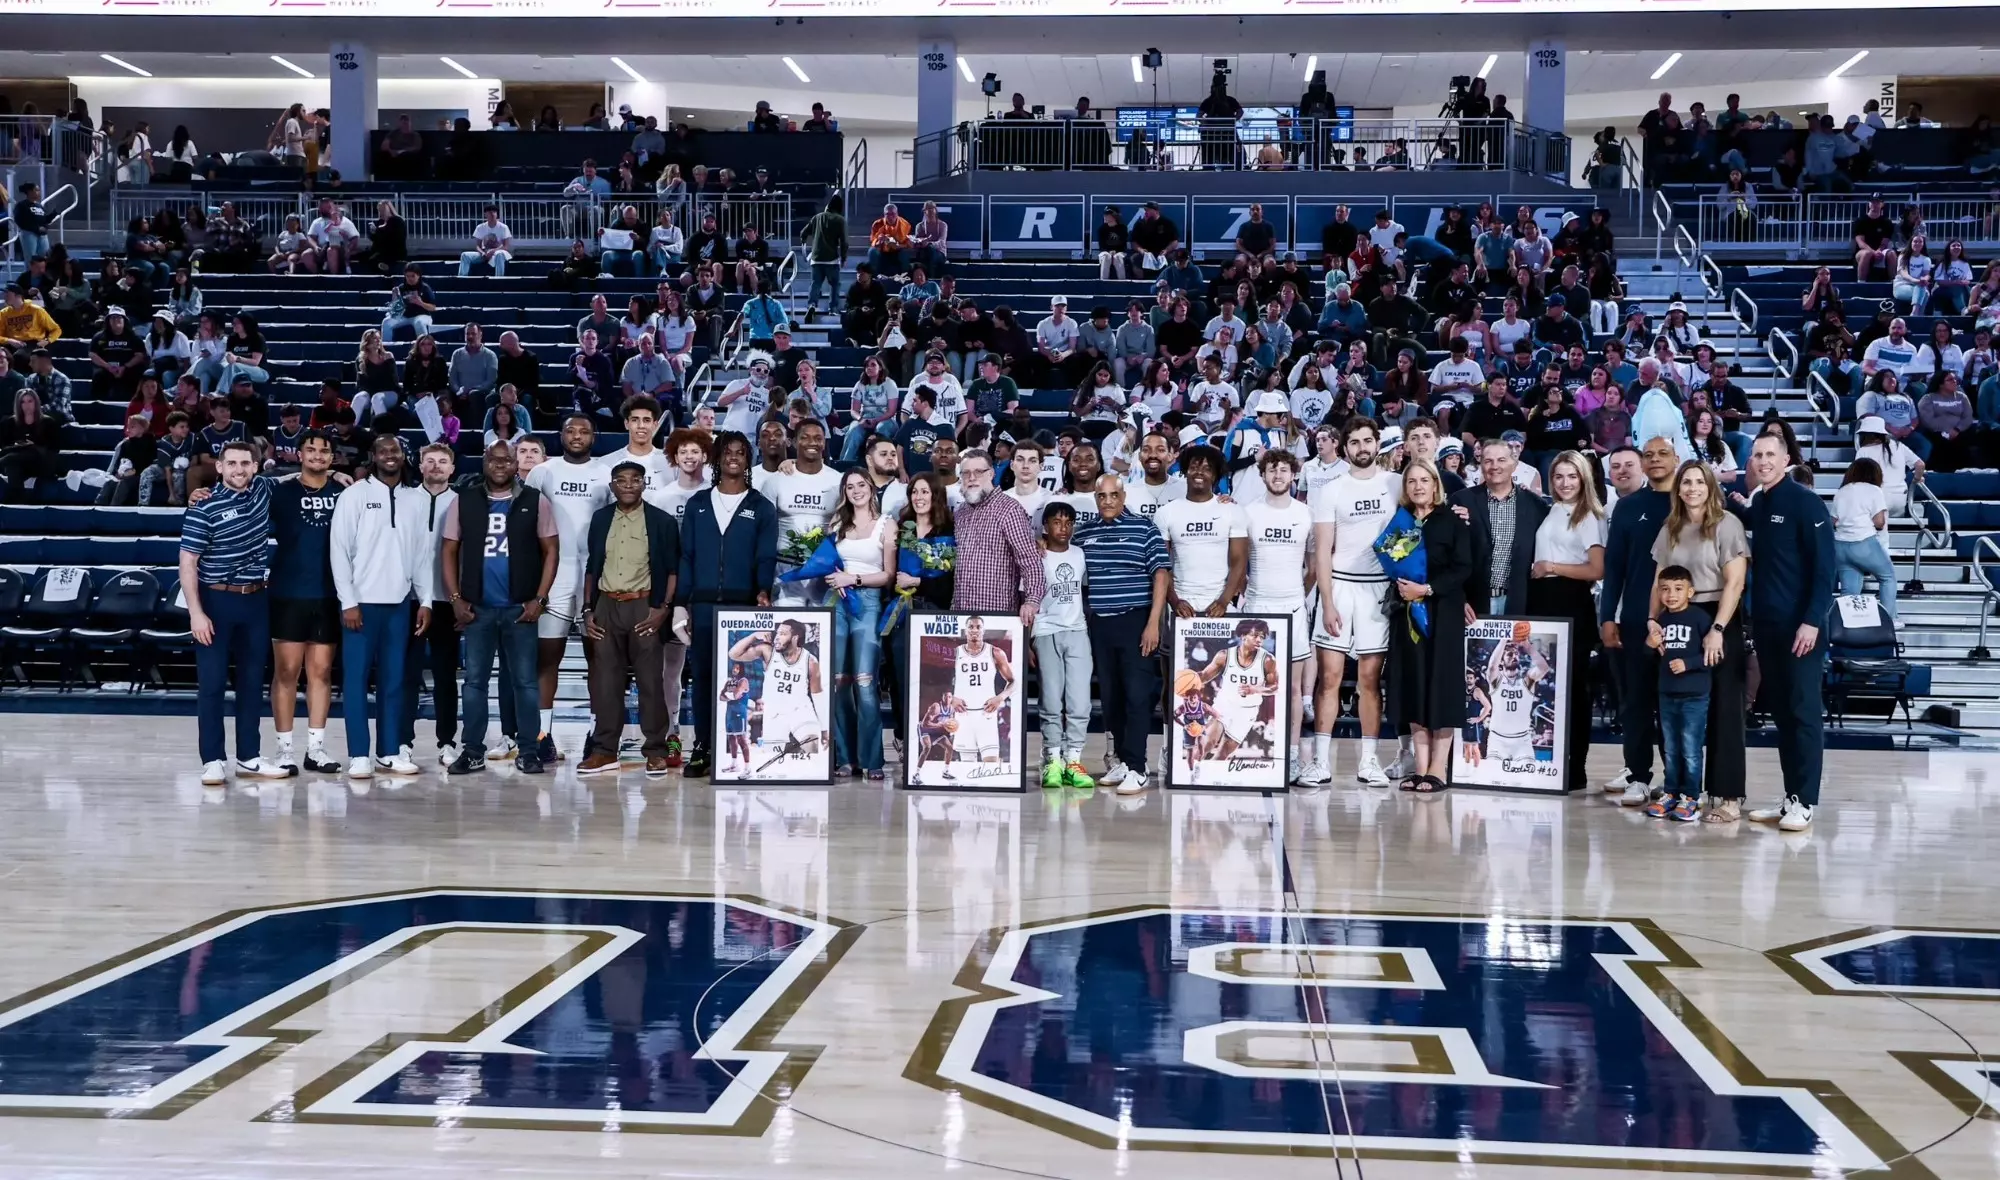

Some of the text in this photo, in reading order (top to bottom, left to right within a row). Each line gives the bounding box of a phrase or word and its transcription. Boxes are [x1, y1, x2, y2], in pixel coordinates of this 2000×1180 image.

[339, 53, 354, 61] 107
[928, 53, 944, 61] 108
[1540, 50, 1557, 58] 109
[927, 62, 943, 70] 109
[1538, 59, 1556, 68] 110
[1881, 82, 1895, 118] MEN
[1118, 118, 1147, 127] OPEN
[1018, 206, 1058, 239] R
[748, 404, 761, 413] UP
[560, 481, 588, 493] CBU
[301, 496, 335, 510] CBU
[793, 494, 821, 505] CBU
[1355, 499, 1381, 511] CBU
[788, 503, 826, 511] BASKETBALL
[221, 508, 239, 520] CBU
[1349, 509, 1387, 517] BASKETBALL
[1770, 514, 1784, 523] CBU
[1186, 522, 1213, 532] CBU
[1264, 528, 1292, 539] CBU
[484, 536, 509, 557] 24
[720, 620, 774, 629] OUEDRAOGO
[924, 622, 959, 635] WADE
[1192, 622, 1231, 630] BLONDEAU
[1484, 621, 1512, 629] HUNTER
[1464, 627, 1512, 639] GOODRICK
[961, 662, 989, 673] CBU
[773, 669, 801, 683] CBU
[969, 674, 982, 686] 21
[1230, 673, 1258, 686] CBU
[777, 681, 793, 694] 24
[1500, 688, 1523, 700] CBU
[1506, 700, 1518, 712] 10
[1537, 765, 1558, 777] #10
